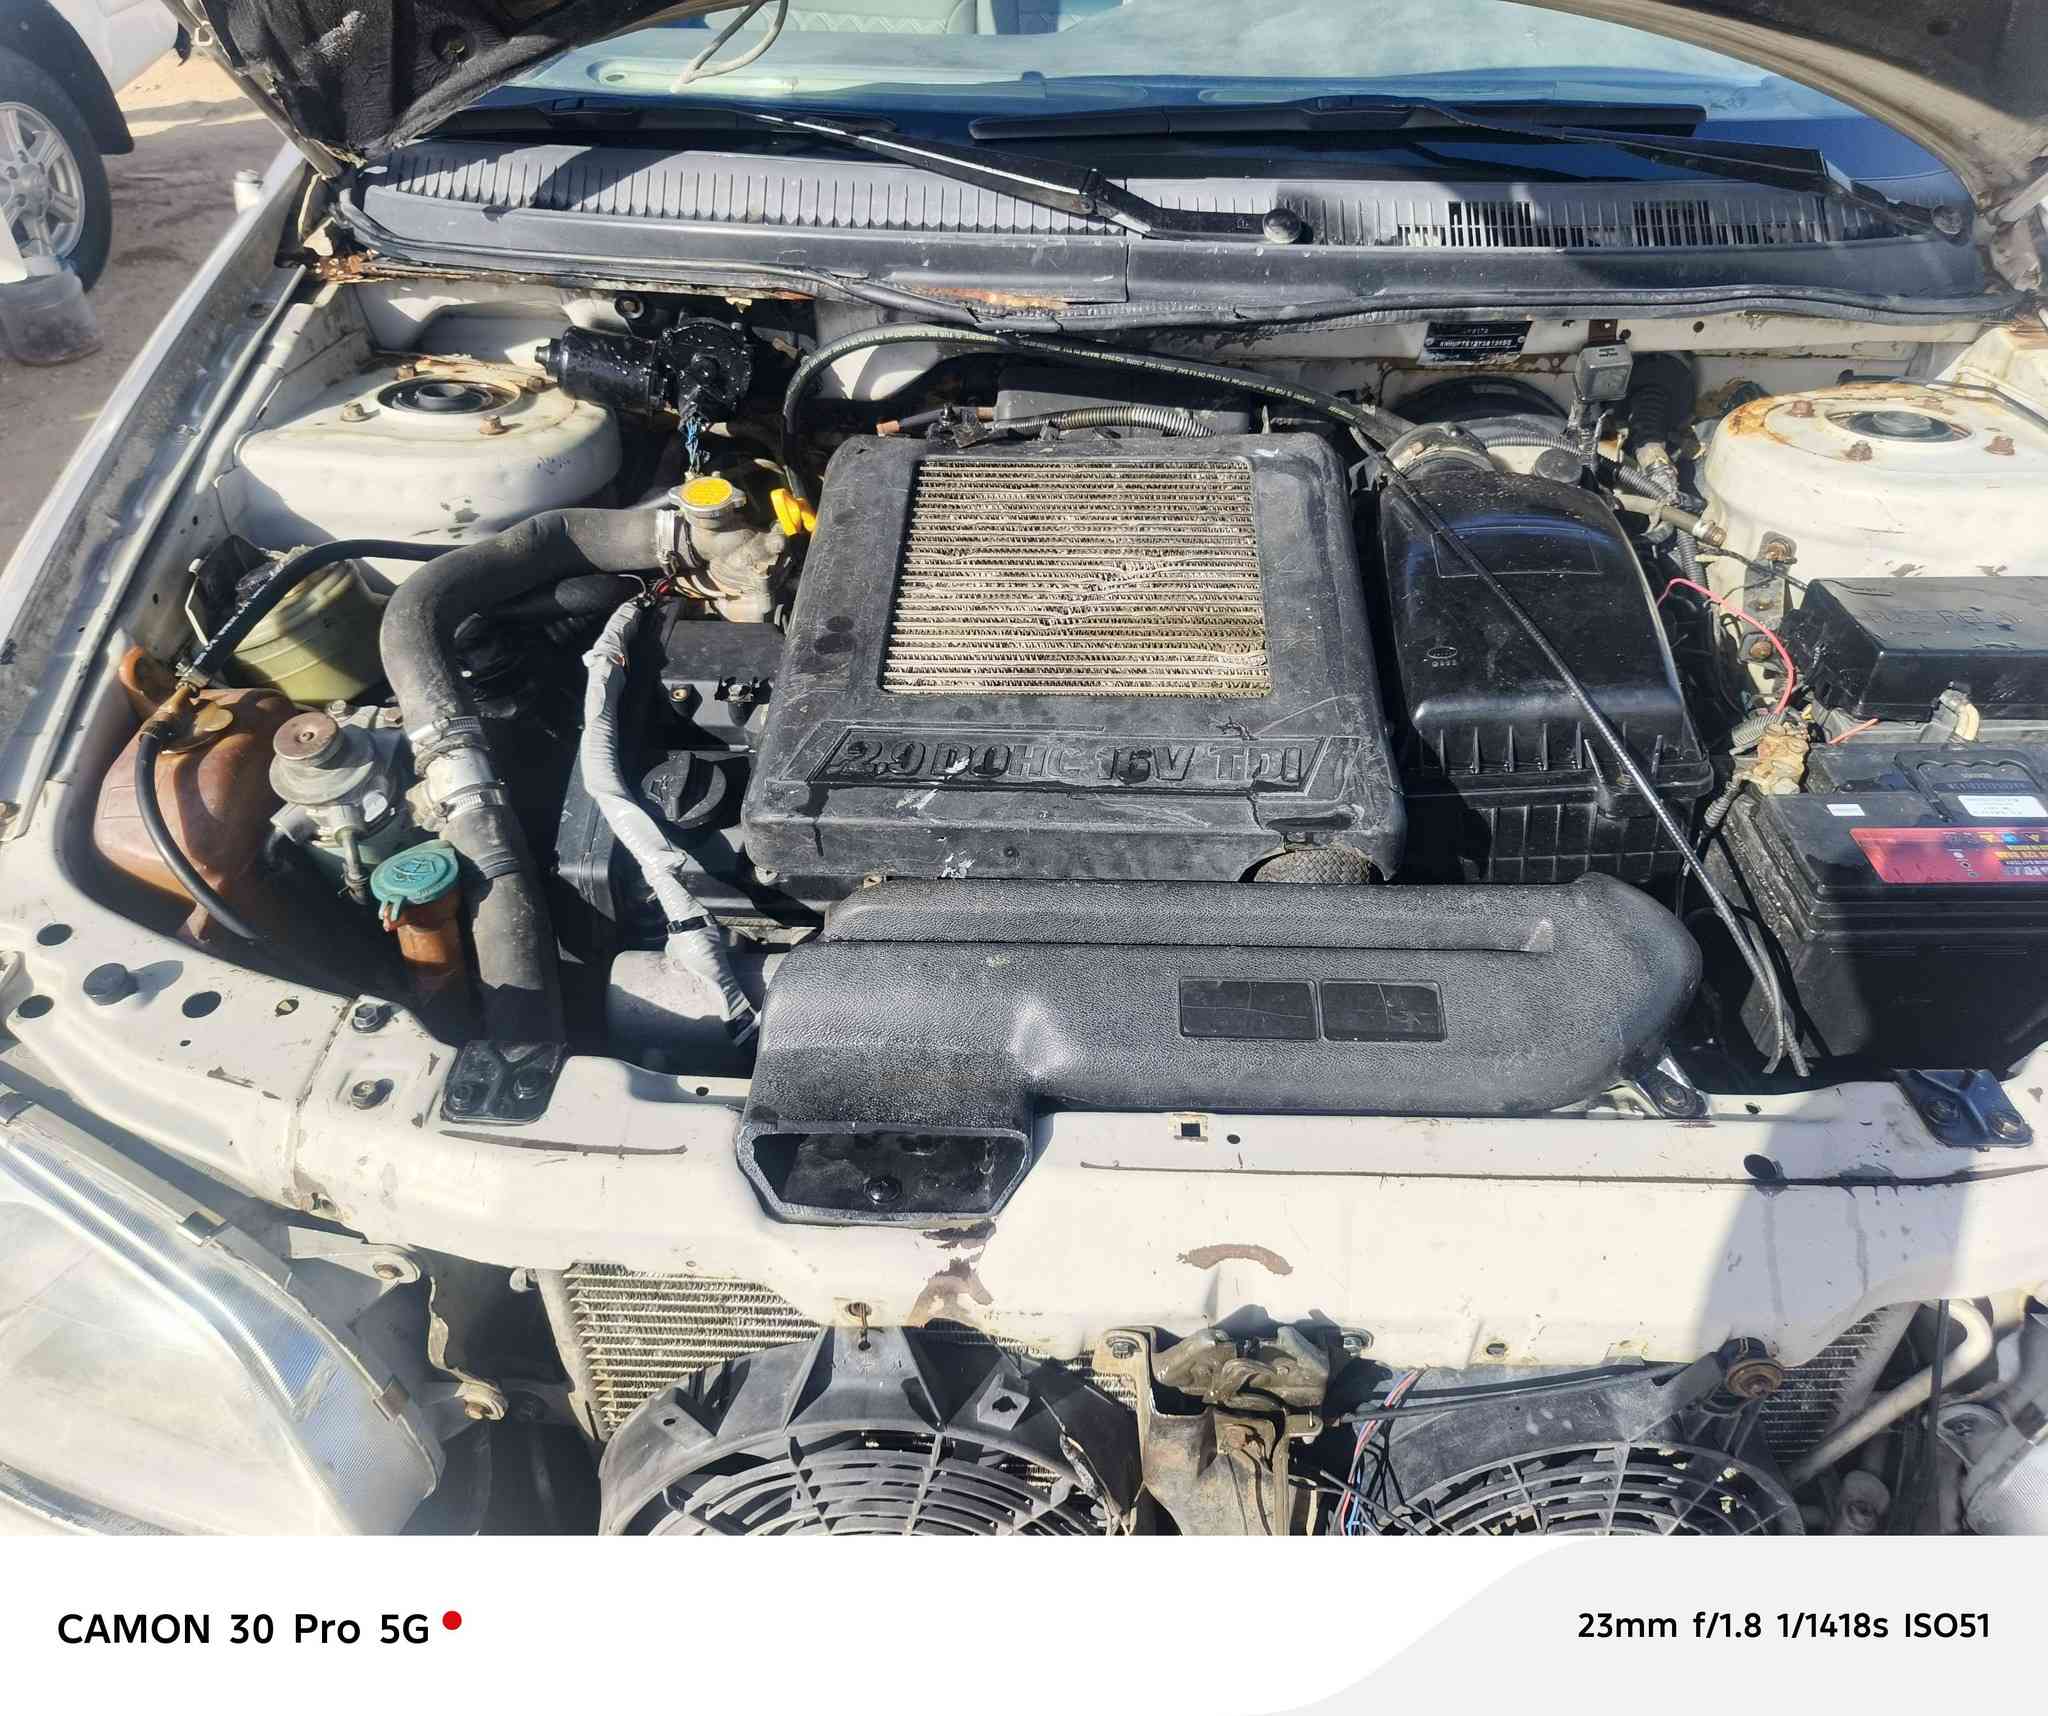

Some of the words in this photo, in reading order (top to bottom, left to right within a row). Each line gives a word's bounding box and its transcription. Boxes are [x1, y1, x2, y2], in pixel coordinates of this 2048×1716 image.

[828, 740, 926, 776] 2.9
[930, 742, 1086, 778] DOHC
[1097, 746, 1196, 784] 16V
